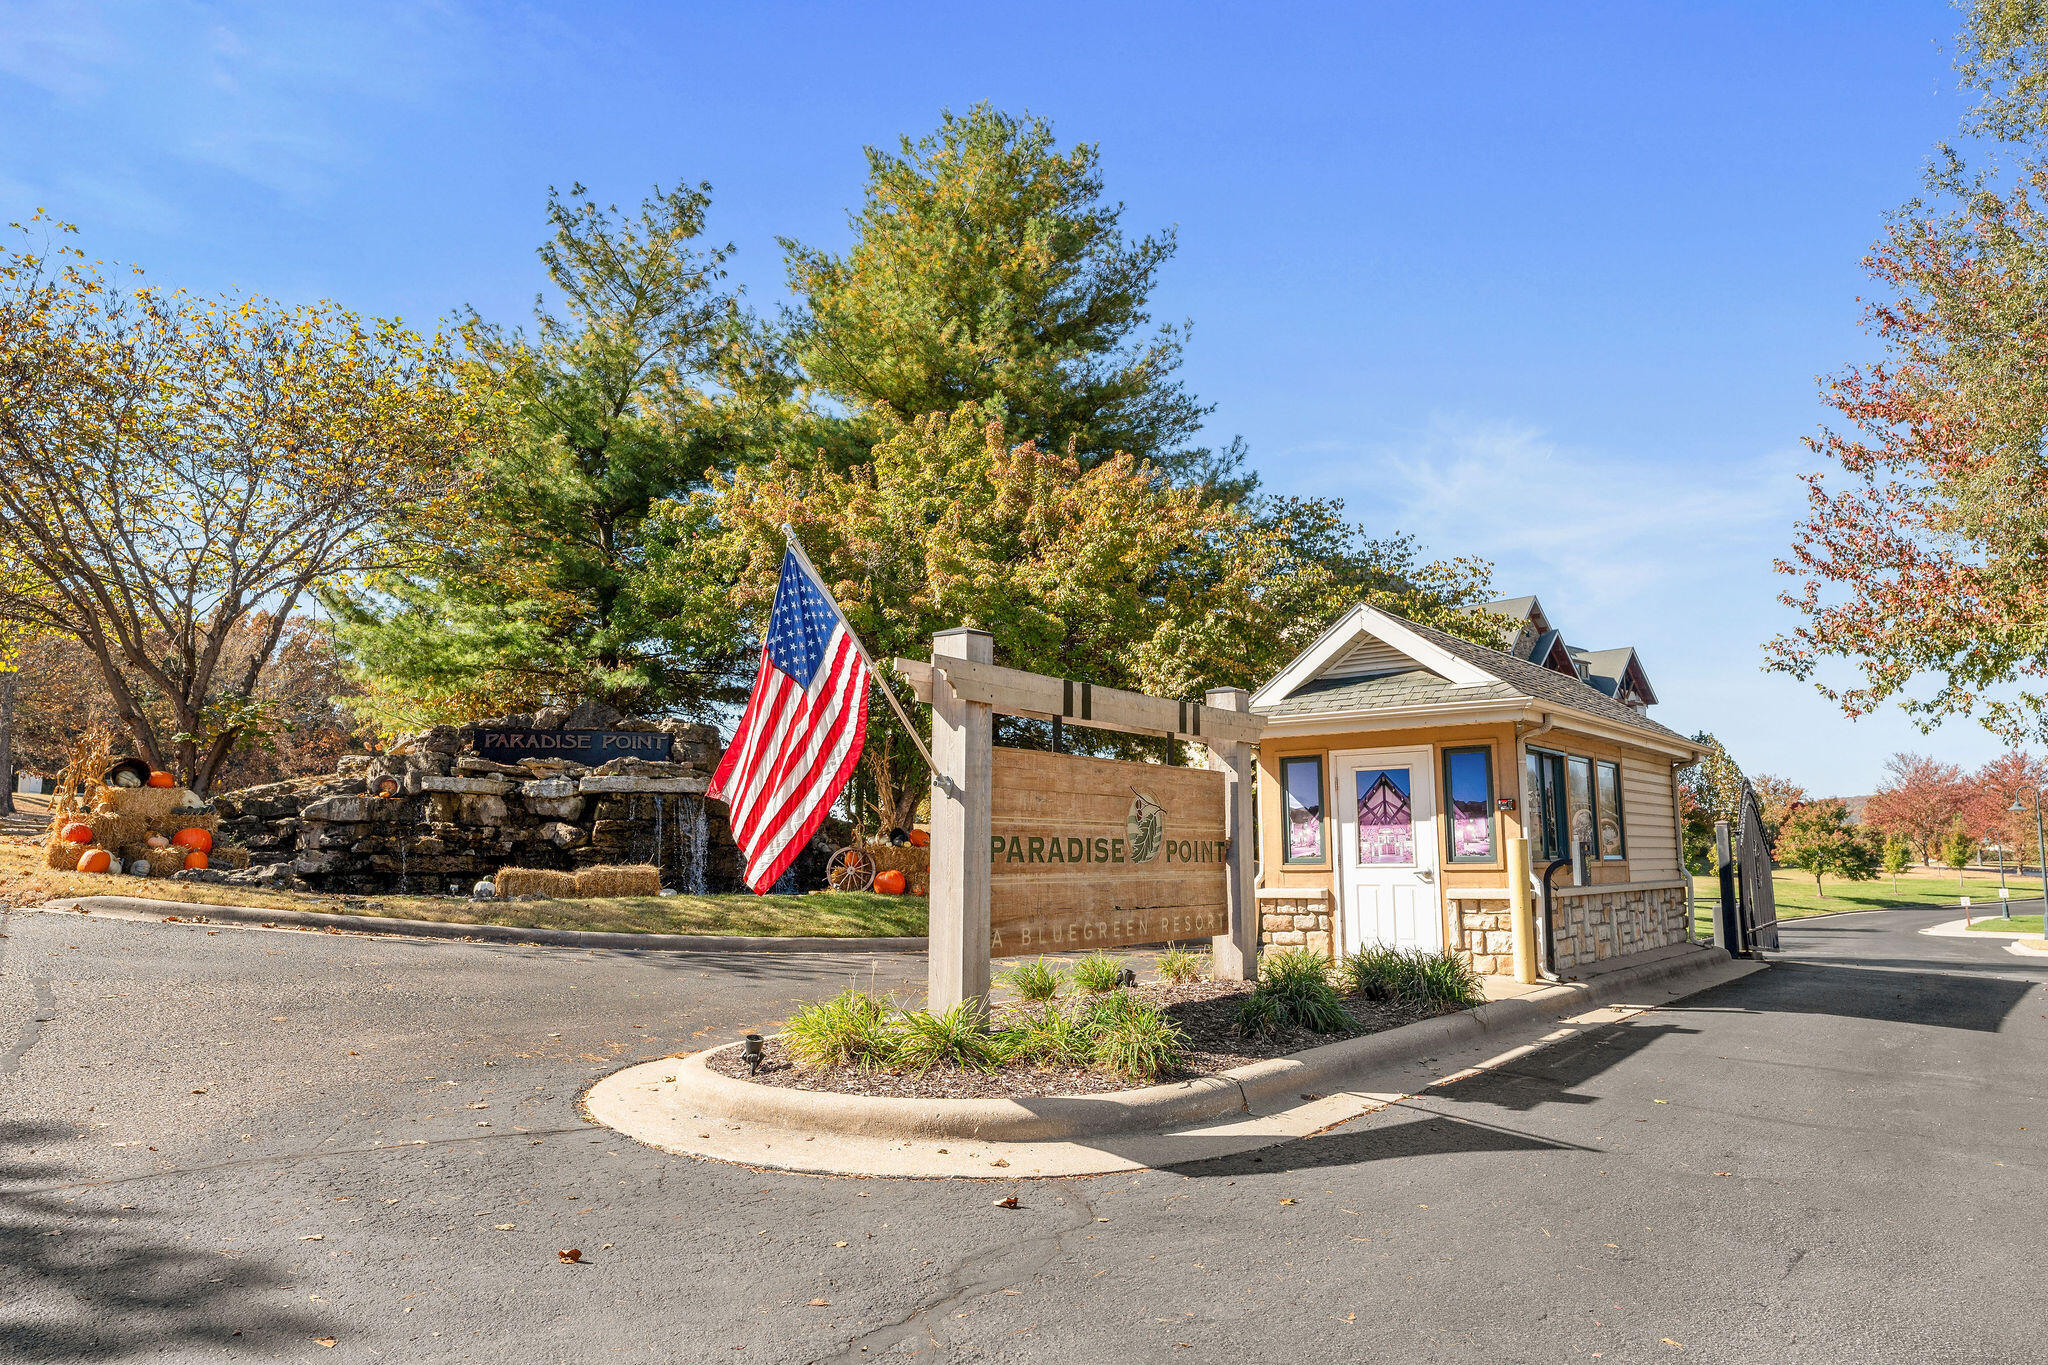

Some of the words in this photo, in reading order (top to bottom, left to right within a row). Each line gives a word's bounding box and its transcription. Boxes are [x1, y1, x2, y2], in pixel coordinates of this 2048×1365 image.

[484, 733, 592, 749] PARADISE
[602, 734, 668, 750] POINT
[991, 835, 1125, 864] PARADISE
[1166, 840, 1226, 863] POINT
[991, 929, 1003, 948] A
[1022, 919, 1148, 946] BLUEGREEN
[1161, 913, 1225, 934] RESORT
